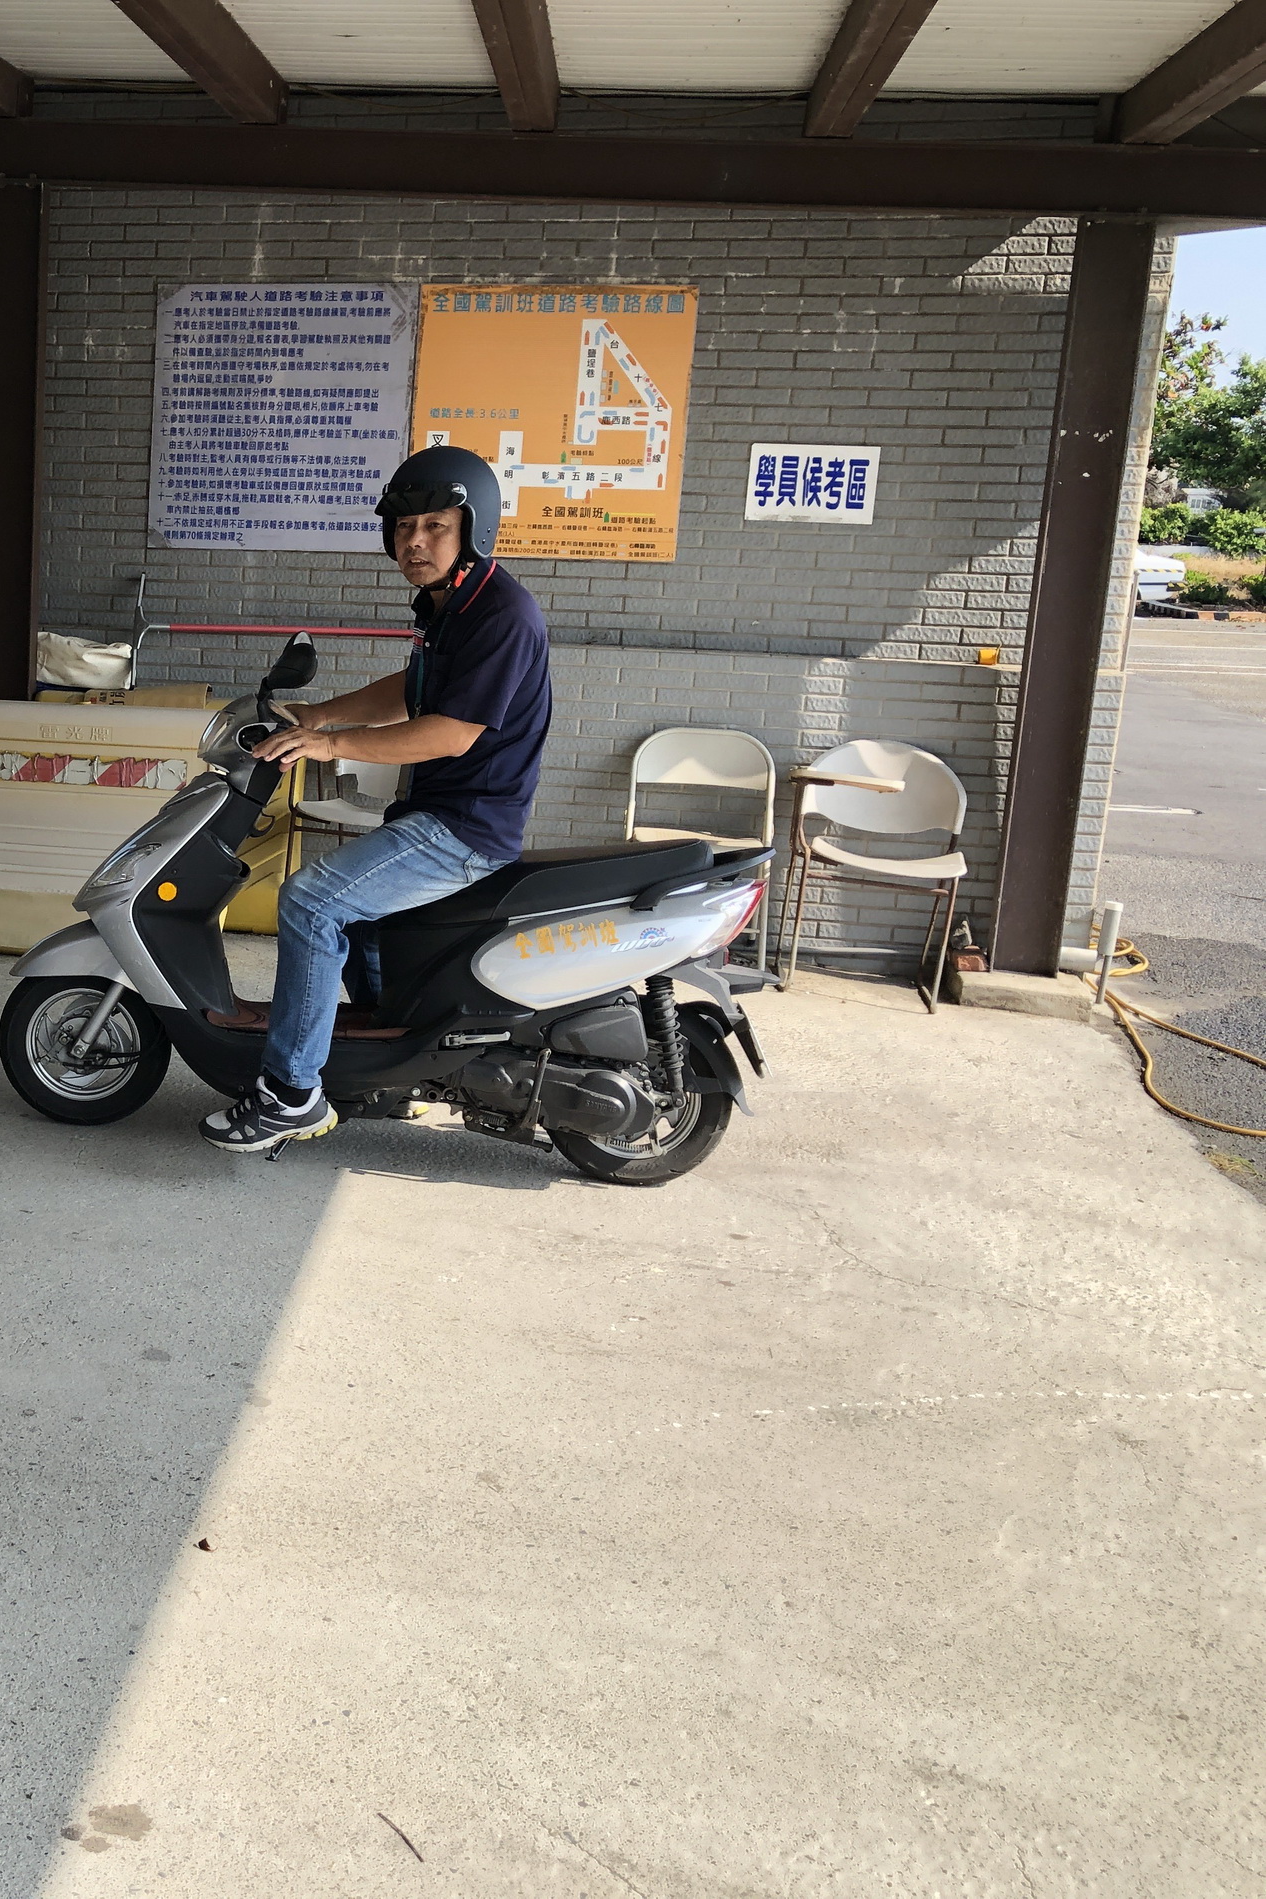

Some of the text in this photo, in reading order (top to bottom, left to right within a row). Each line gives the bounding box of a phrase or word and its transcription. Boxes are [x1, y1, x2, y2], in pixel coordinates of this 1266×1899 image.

[190, 290, 385, 302] 汽車駕駛人道路考驗注意事項
[433, 293, 685, 314] 全國駕訓班道路考驗路線圖
[754, 454, 870, 510] 學員候考區
[542, 505, 604, 518] 全國駕訓班
[514, 918, 619, 960] 全國駕訓班
